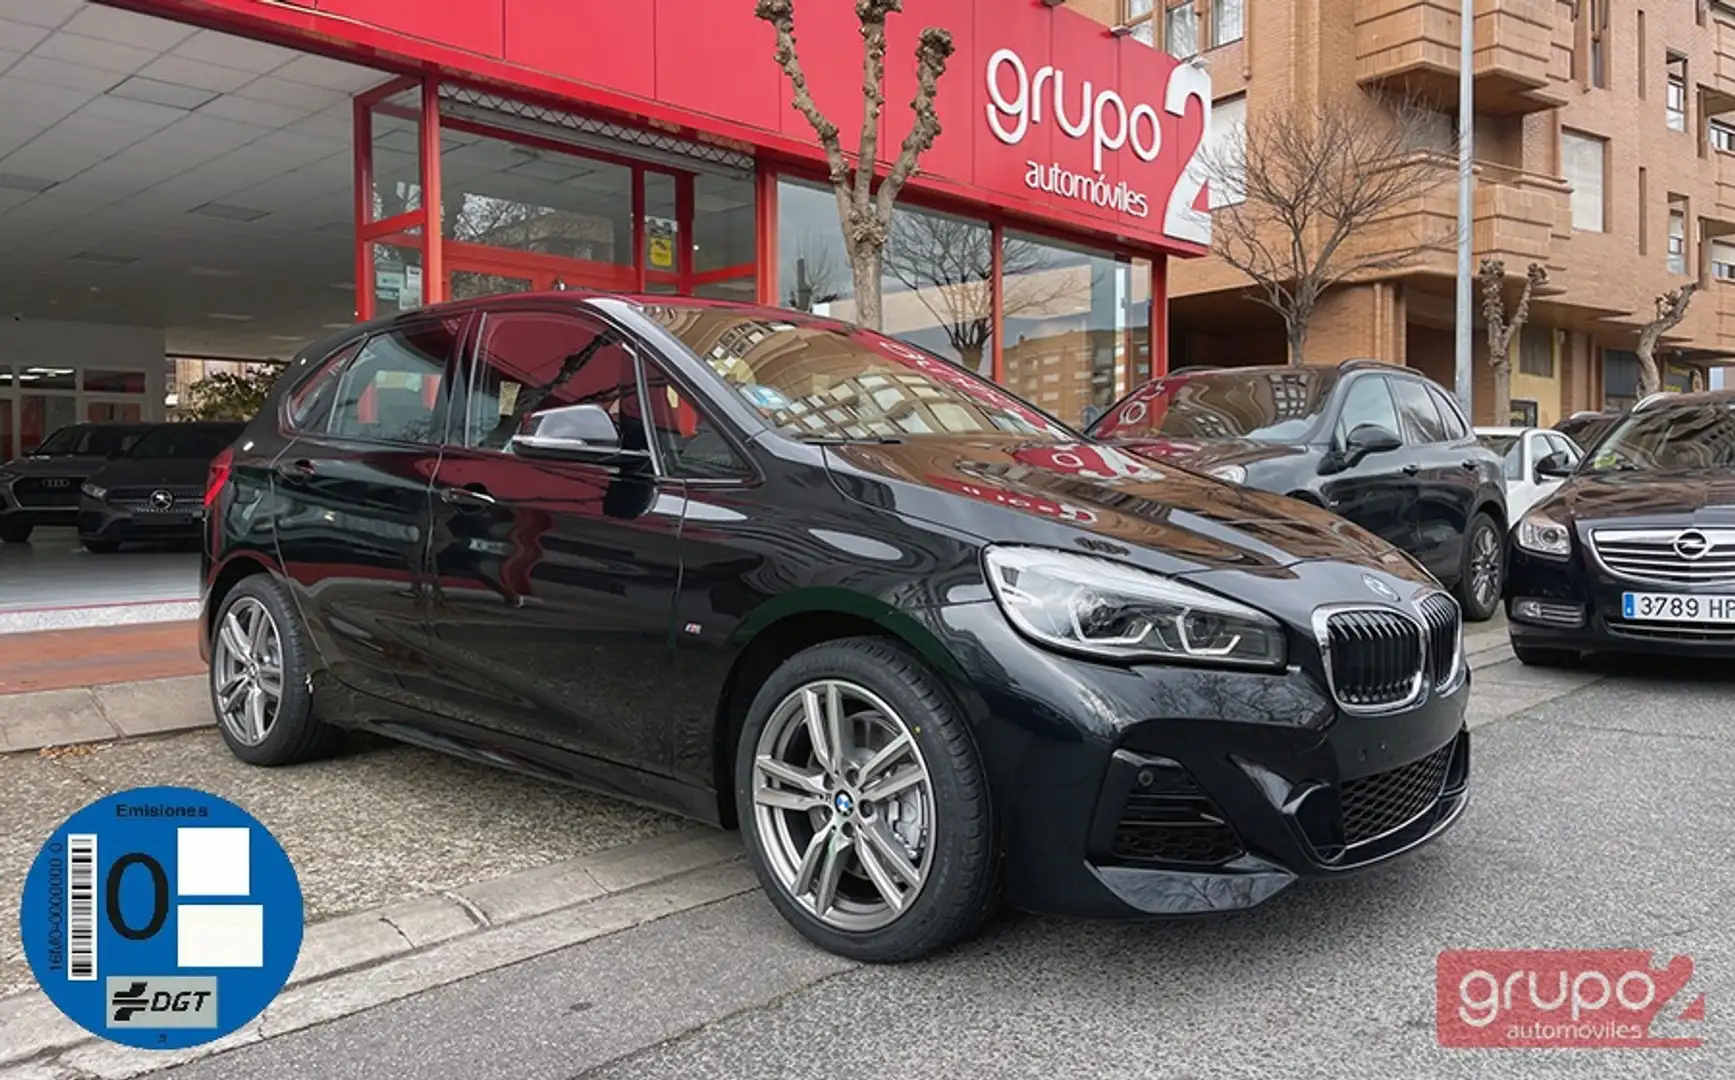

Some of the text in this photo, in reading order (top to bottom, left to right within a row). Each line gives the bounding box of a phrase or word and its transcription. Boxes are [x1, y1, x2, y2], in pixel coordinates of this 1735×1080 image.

[986, 48, 1212, 245] grupo 2
[1025, 160, 1148, 217] automóviles
[1640, 596, 1699, 617] 3789
